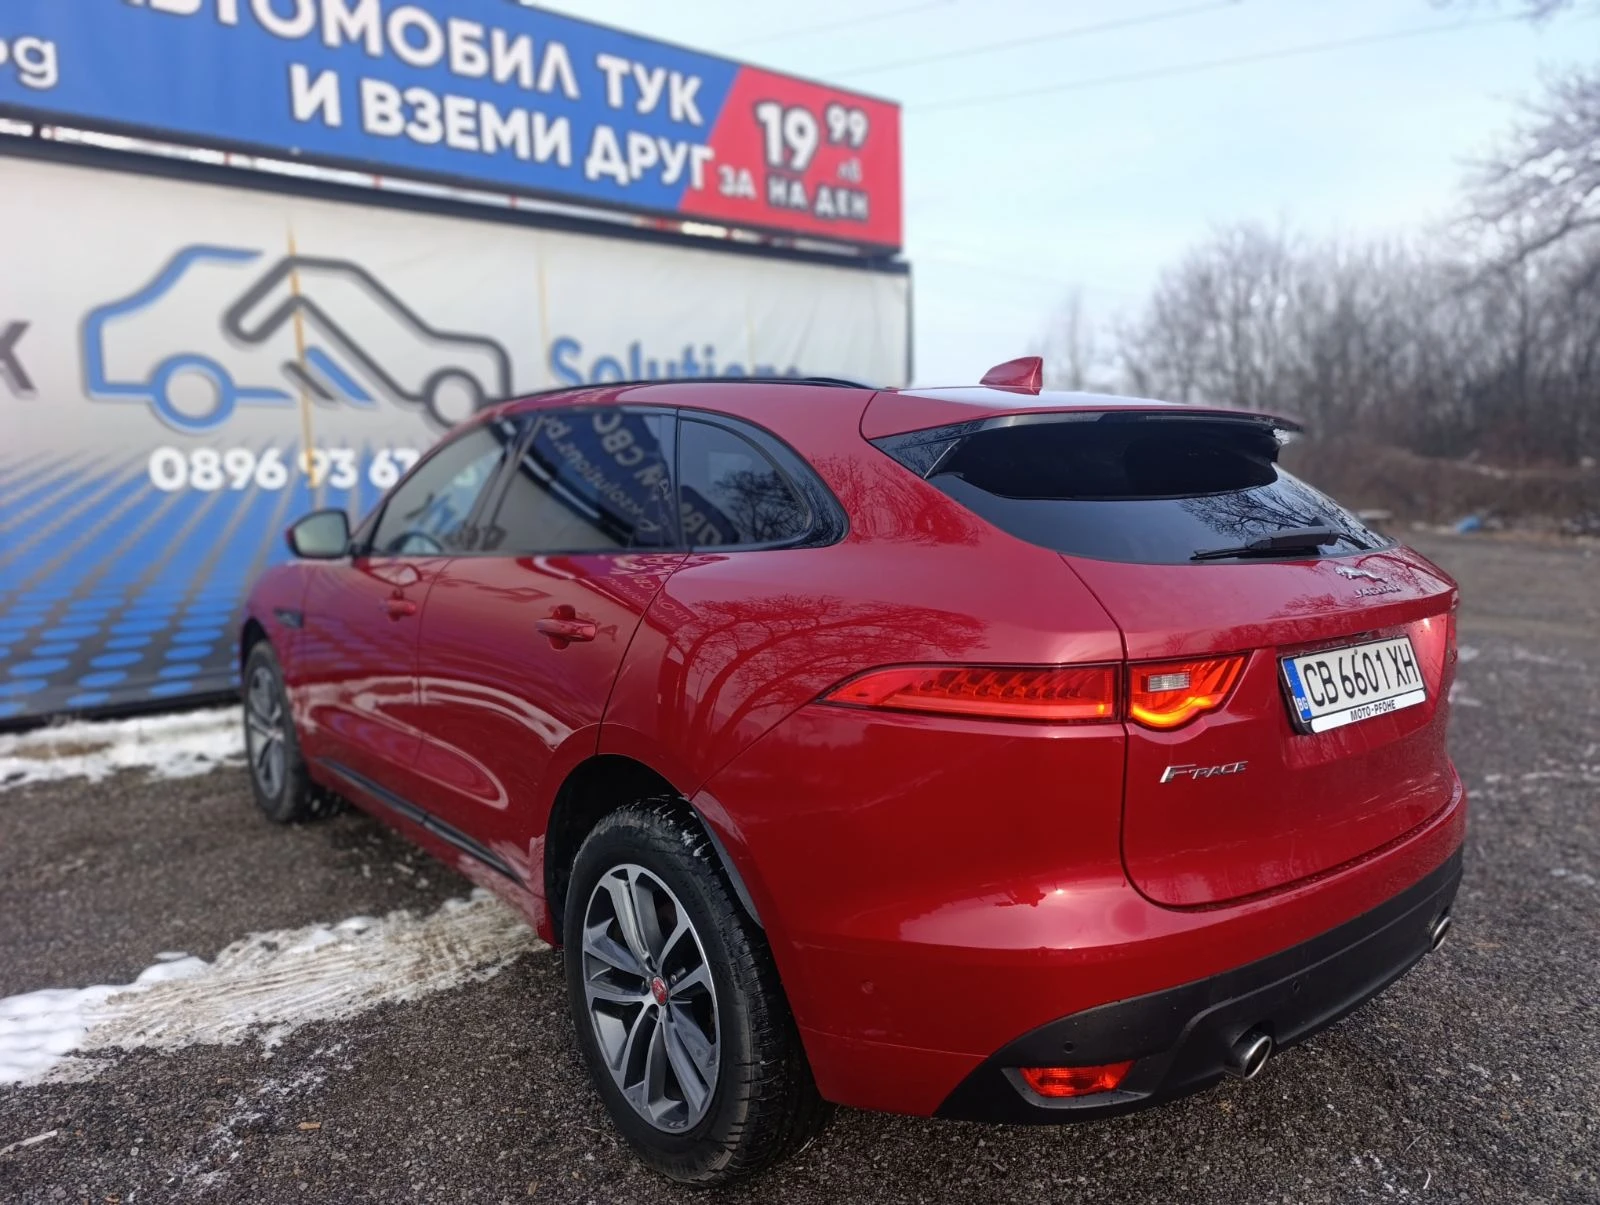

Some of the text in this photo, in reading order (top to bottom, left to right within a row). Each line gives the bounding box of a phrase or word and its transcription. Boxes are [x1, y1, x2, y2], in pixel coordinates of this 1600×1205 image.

[123, 0, 704, 125] ОМОБИЛ ТУК
[290, 63, 756, 200] И ВЗЕМИ ДРУГ ЗА
[755, 102, 869, 172] 19 99
[767, 174, 869, 221] НА ДЕН
[148, 446, 420, 491] 0896 93 67
[1303, 643, 1419, 707] CB 6601 XH
[1350, 699, 1396, 722] MOTO-PFOHE
